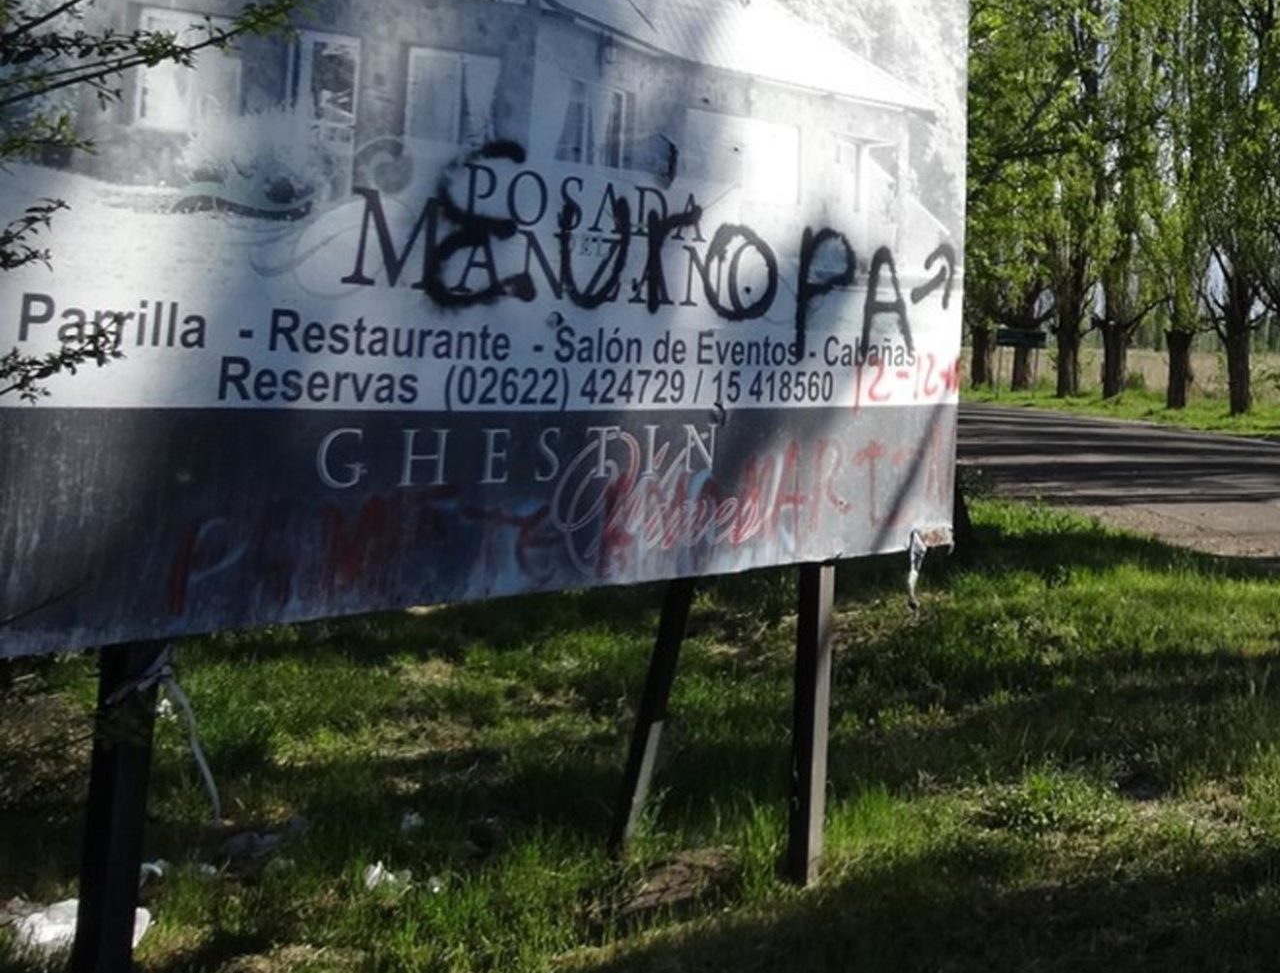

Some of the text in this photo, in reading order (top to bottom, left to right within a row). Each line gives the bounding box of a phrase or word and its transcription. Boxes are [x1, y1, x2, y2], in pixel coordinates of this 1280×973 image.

[463, 163, 706, 243] POSADA
[18, 292, 207, 349] Parrilla
[269, 308, 510, 361] Restaurante
[554, 326, 642, 365] Salón
[652, 329, 687, 365] de
[696, 331, 800, 367] Eventos
[824, 335, 917, 367] Cabañas
[218, 356, 418, 404] Reservas
[444, 364, 570, 412] (02622)
[580, 368, 685, 405] 424729
[712, 370, 742, 404] 15
[748, 370, 834, 403] 418560
[316, 424, 718, 489] GHESTIN
